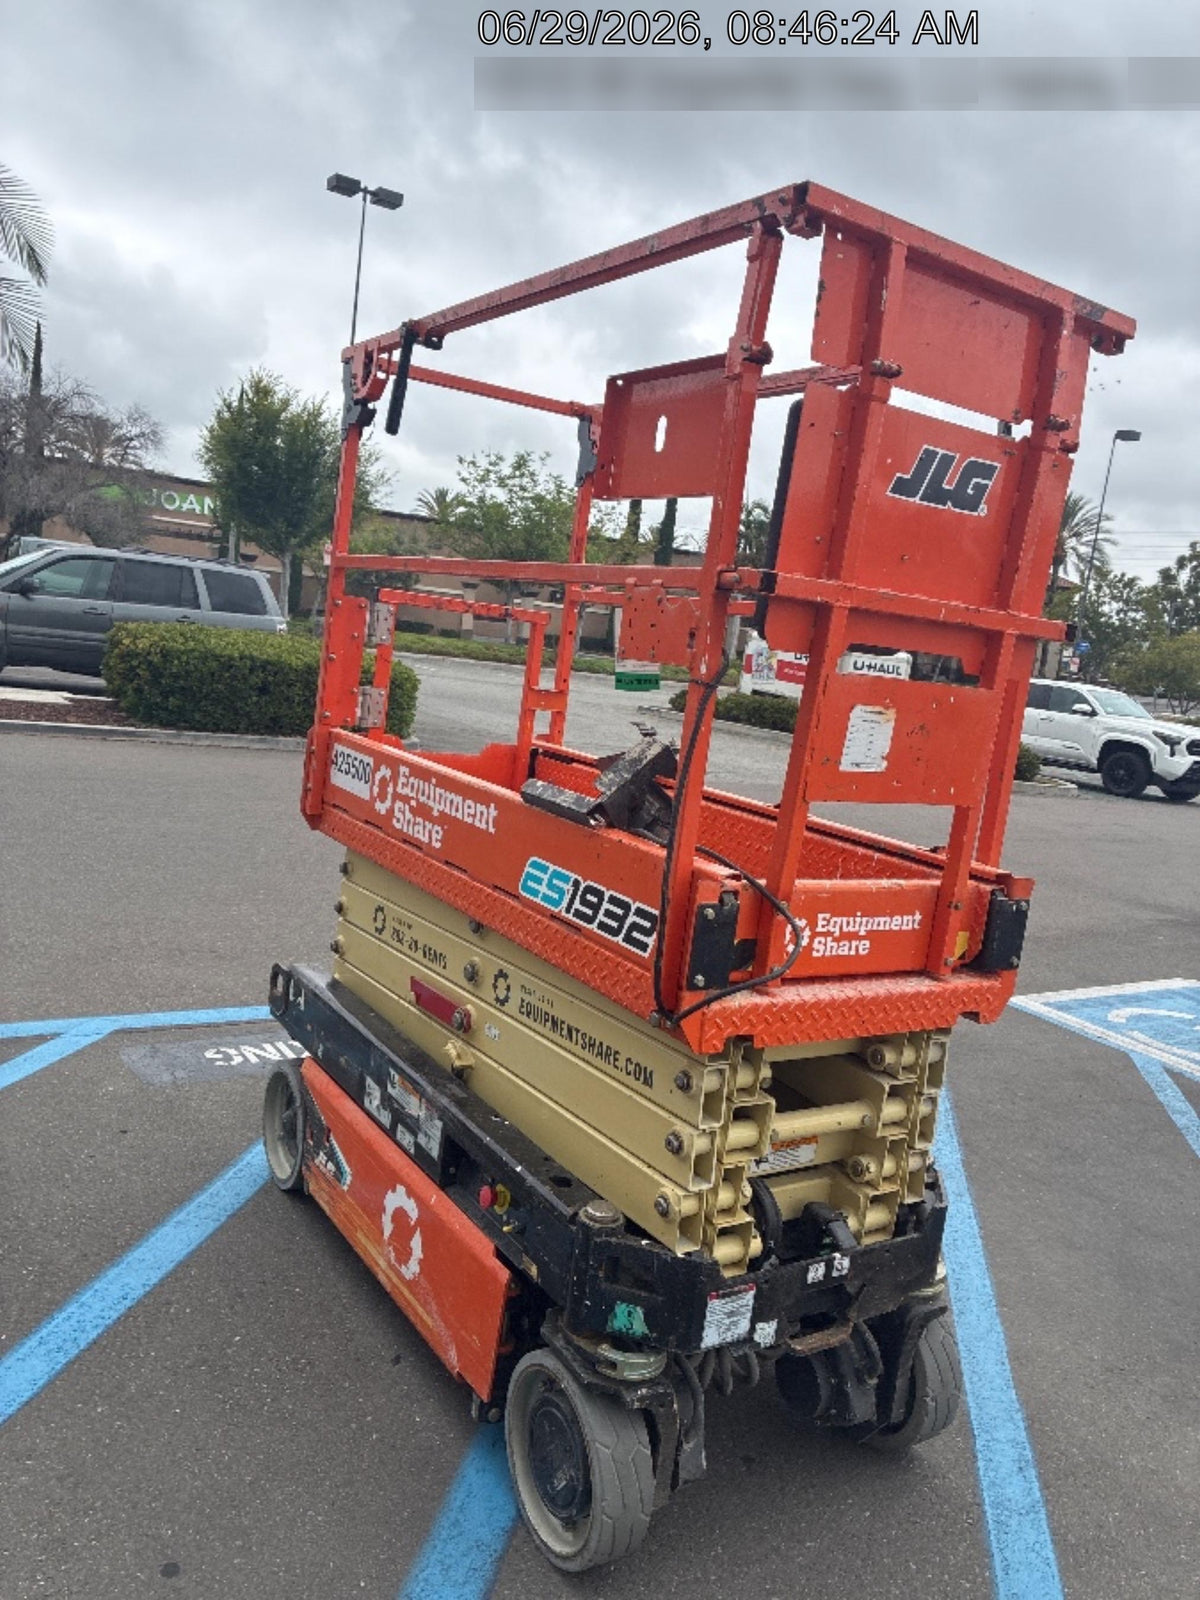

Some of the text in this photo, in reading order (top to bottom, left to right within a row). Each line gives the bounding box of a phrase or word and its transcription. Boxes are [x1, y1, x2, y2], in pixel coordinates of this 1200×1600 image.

[887, 444, 1001, 515] JLG
[853, 659, 902, 677] U-HAUL
[392, 801, 443, 848] Share
[397, 766, 498, 834] Equipment
[519, 856, 659, 957] ES1932
[815, 910, 921, 937] Equipment
[812, 937, 870, 957] Share
[518, 998, 654, 1089] EQUIPMENTSHARE.COM
